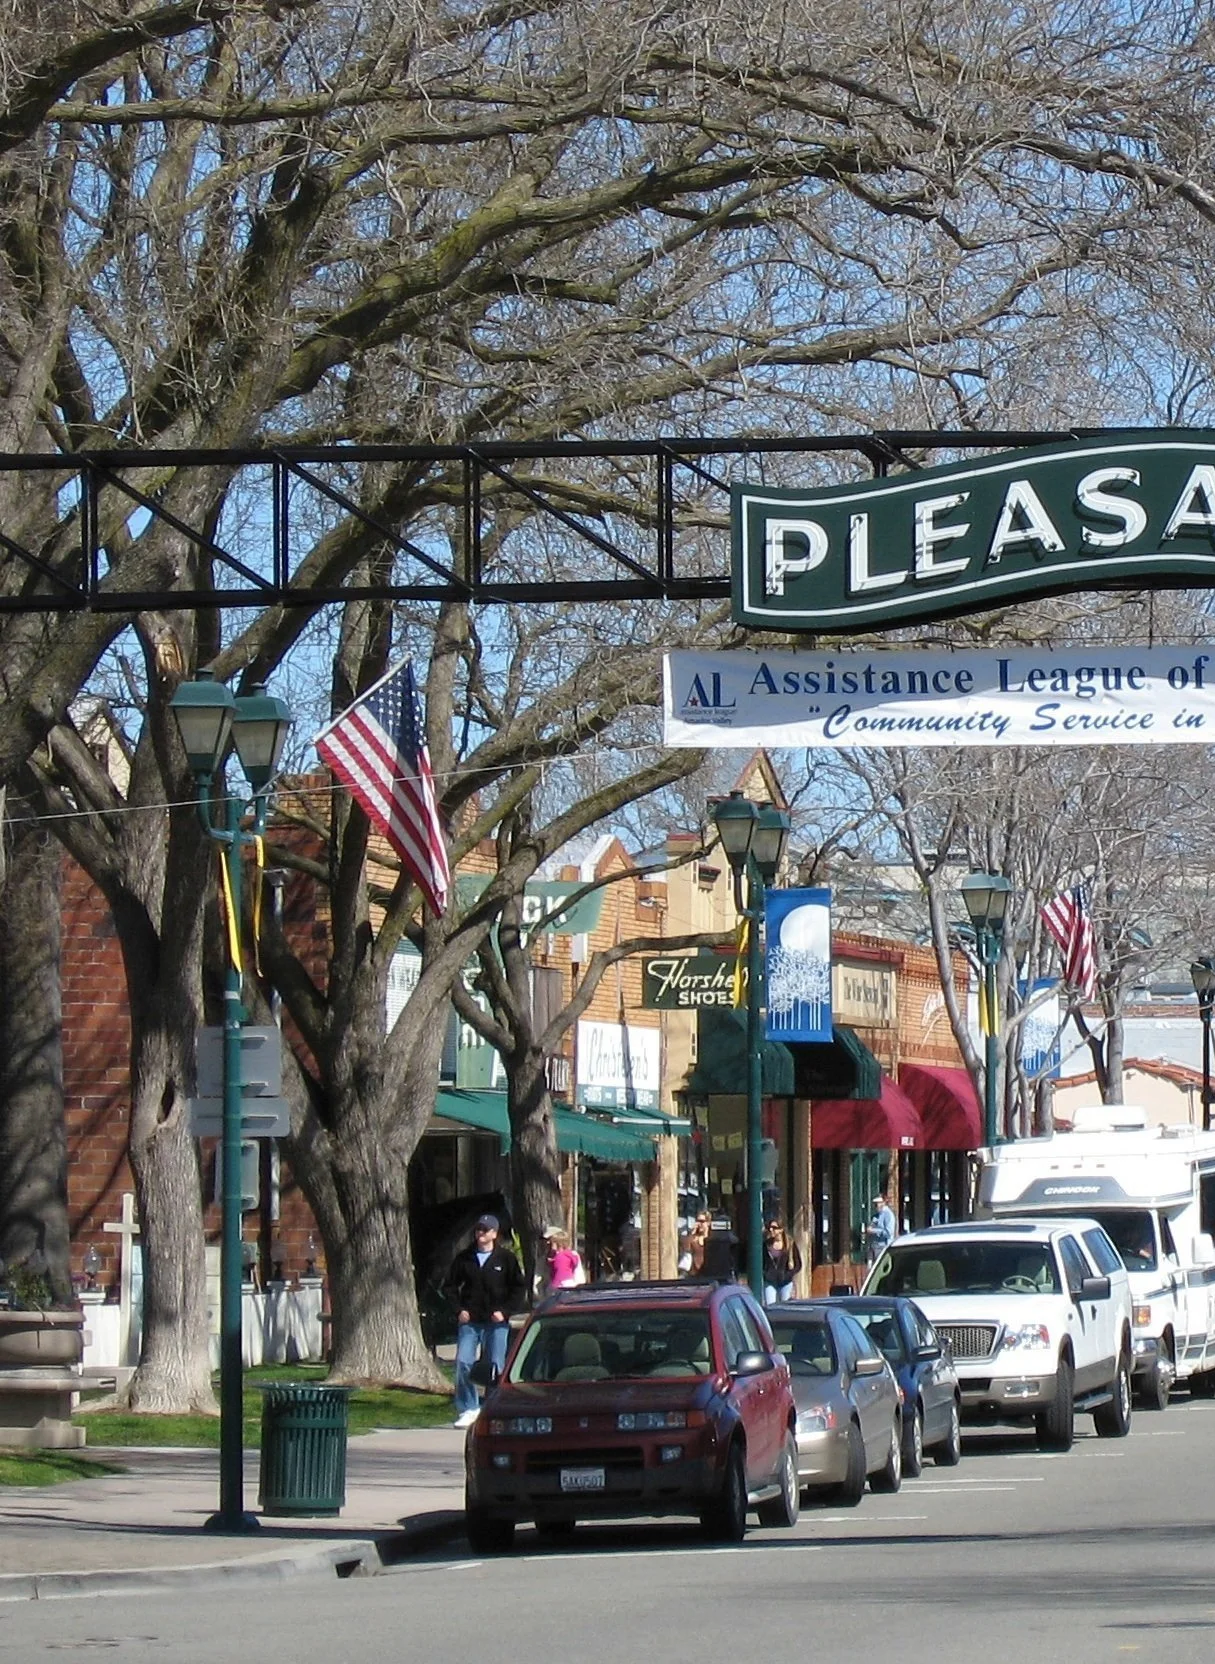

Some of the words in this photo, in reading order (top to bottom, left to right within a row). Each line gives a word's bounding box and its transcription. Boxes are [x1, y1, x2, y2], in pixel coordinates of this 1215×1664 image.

[682, 671, 737, 708] AL
[748, 661, 974, 694] Assistance
[996, 658, 1147, 698] League
[1167, 655, 1210, 690] of
[1029, 702, 1154, 731] Service
[1172, 706, 1206, 729] in
[1044, 1186, 1101, 1196] CHINOOK
